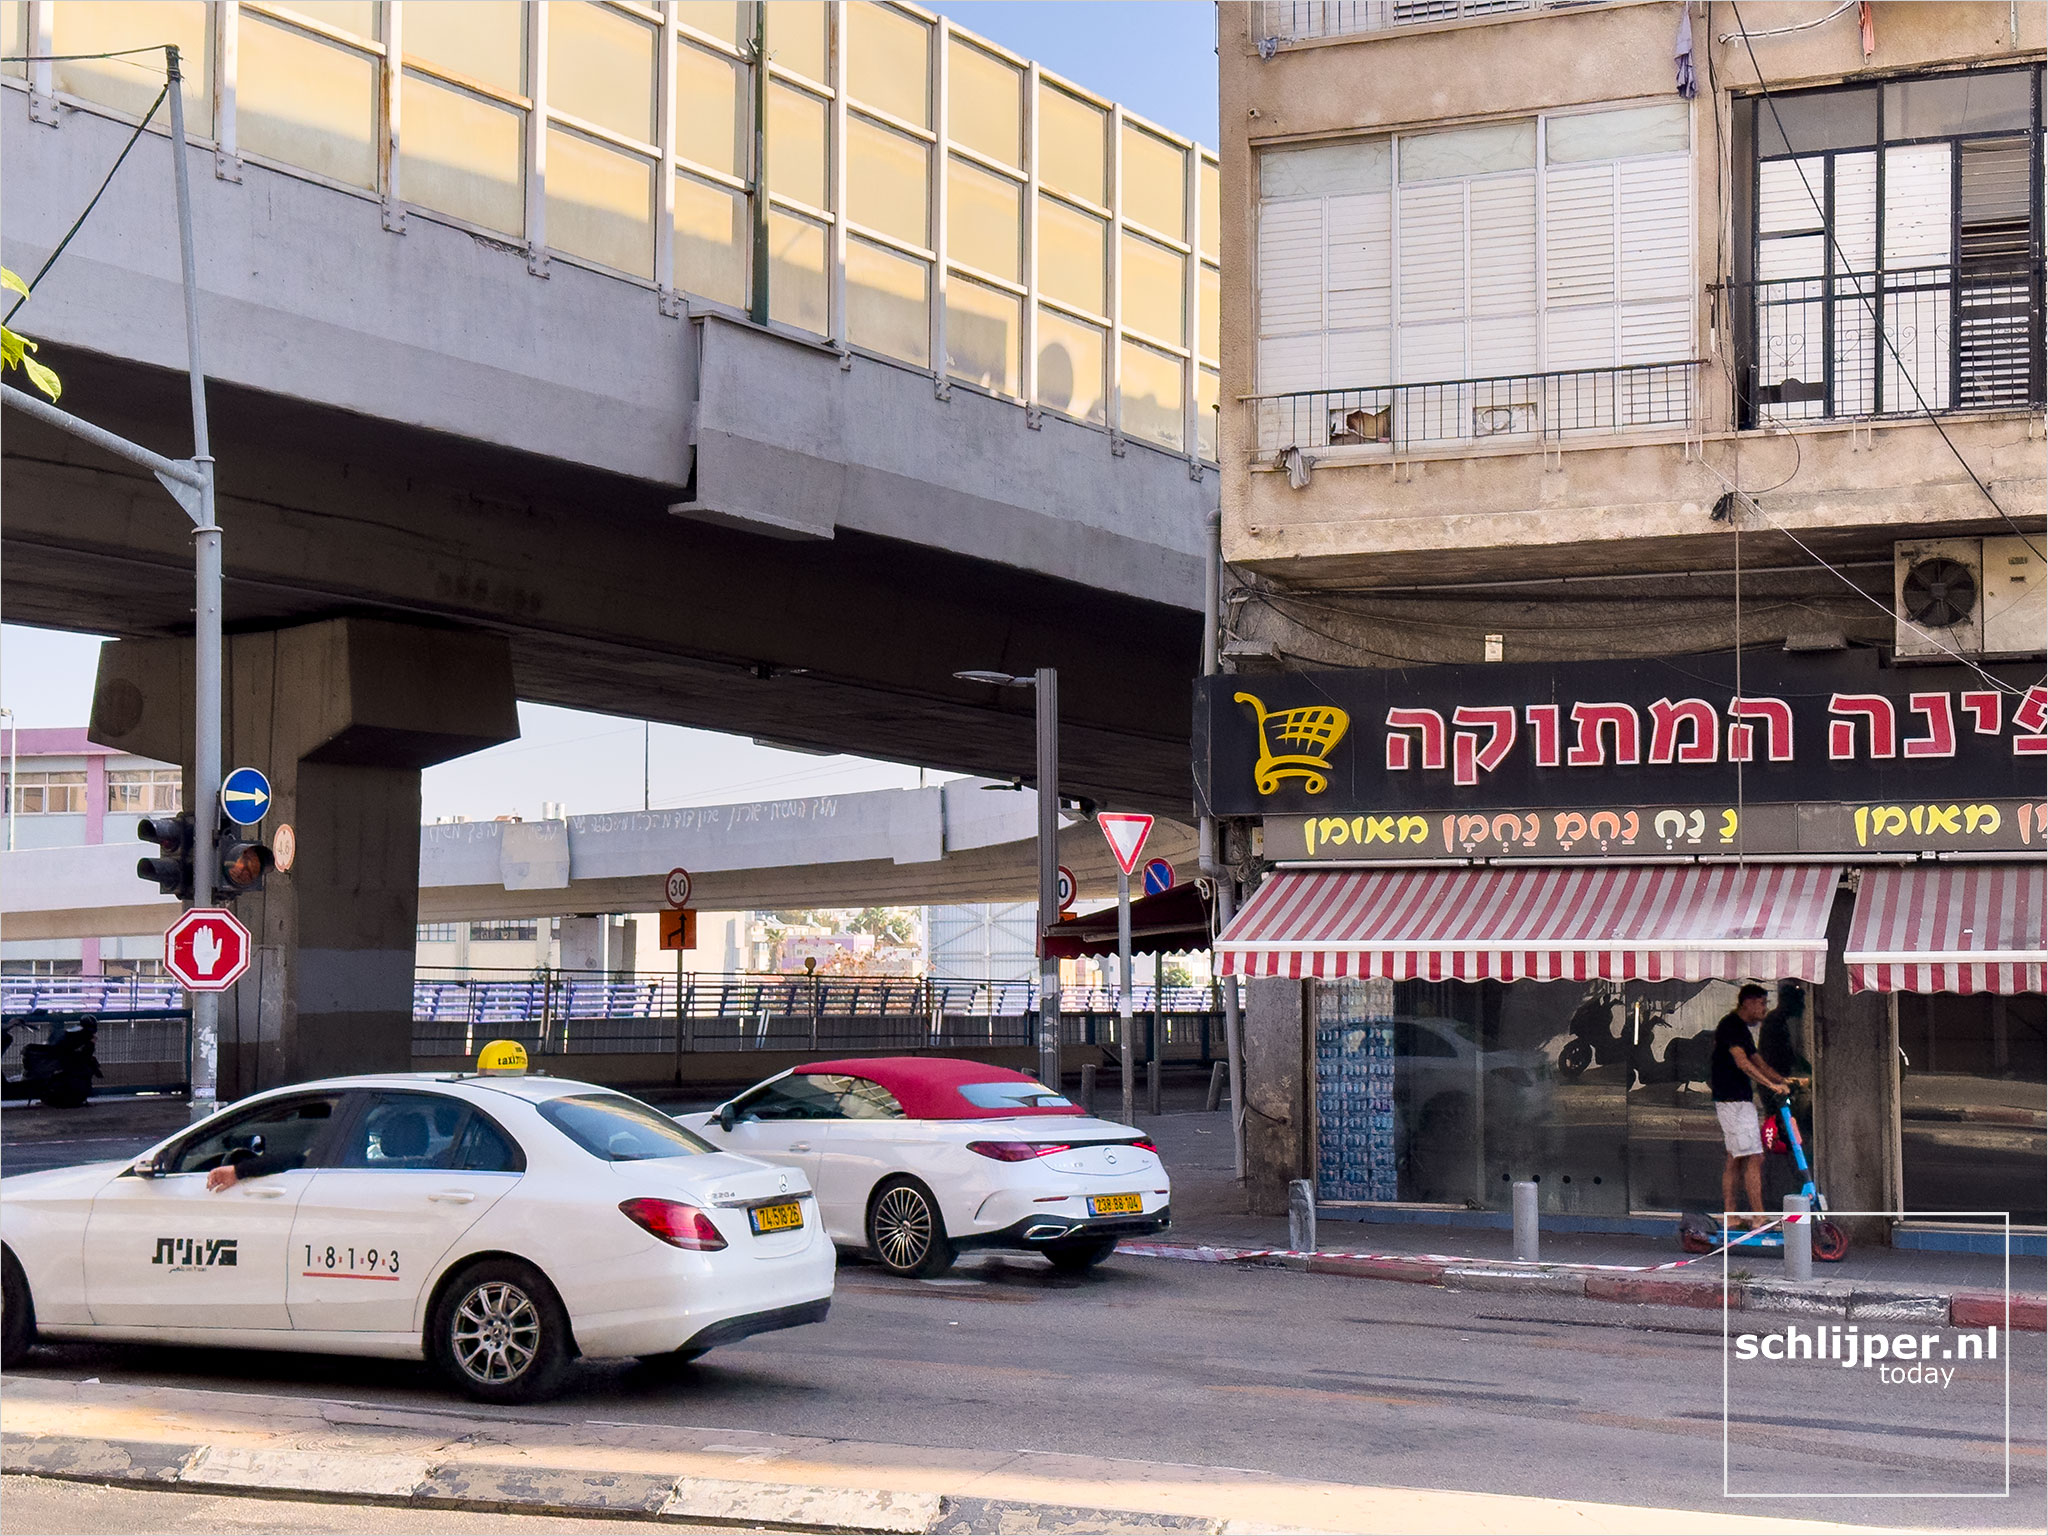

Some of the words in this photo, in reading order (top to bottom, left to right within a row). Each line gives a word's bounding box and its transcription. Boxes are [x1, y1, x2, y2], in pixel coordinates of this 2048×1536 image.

[1386, 697, 1793, 785] המתוקה
[1304, 815, 1429, 855] מאומן
[1854, 804, 2001, 847] מאומן
[670, 879, 686, 897] 30
[1058, 879, 1069, 898] 0
